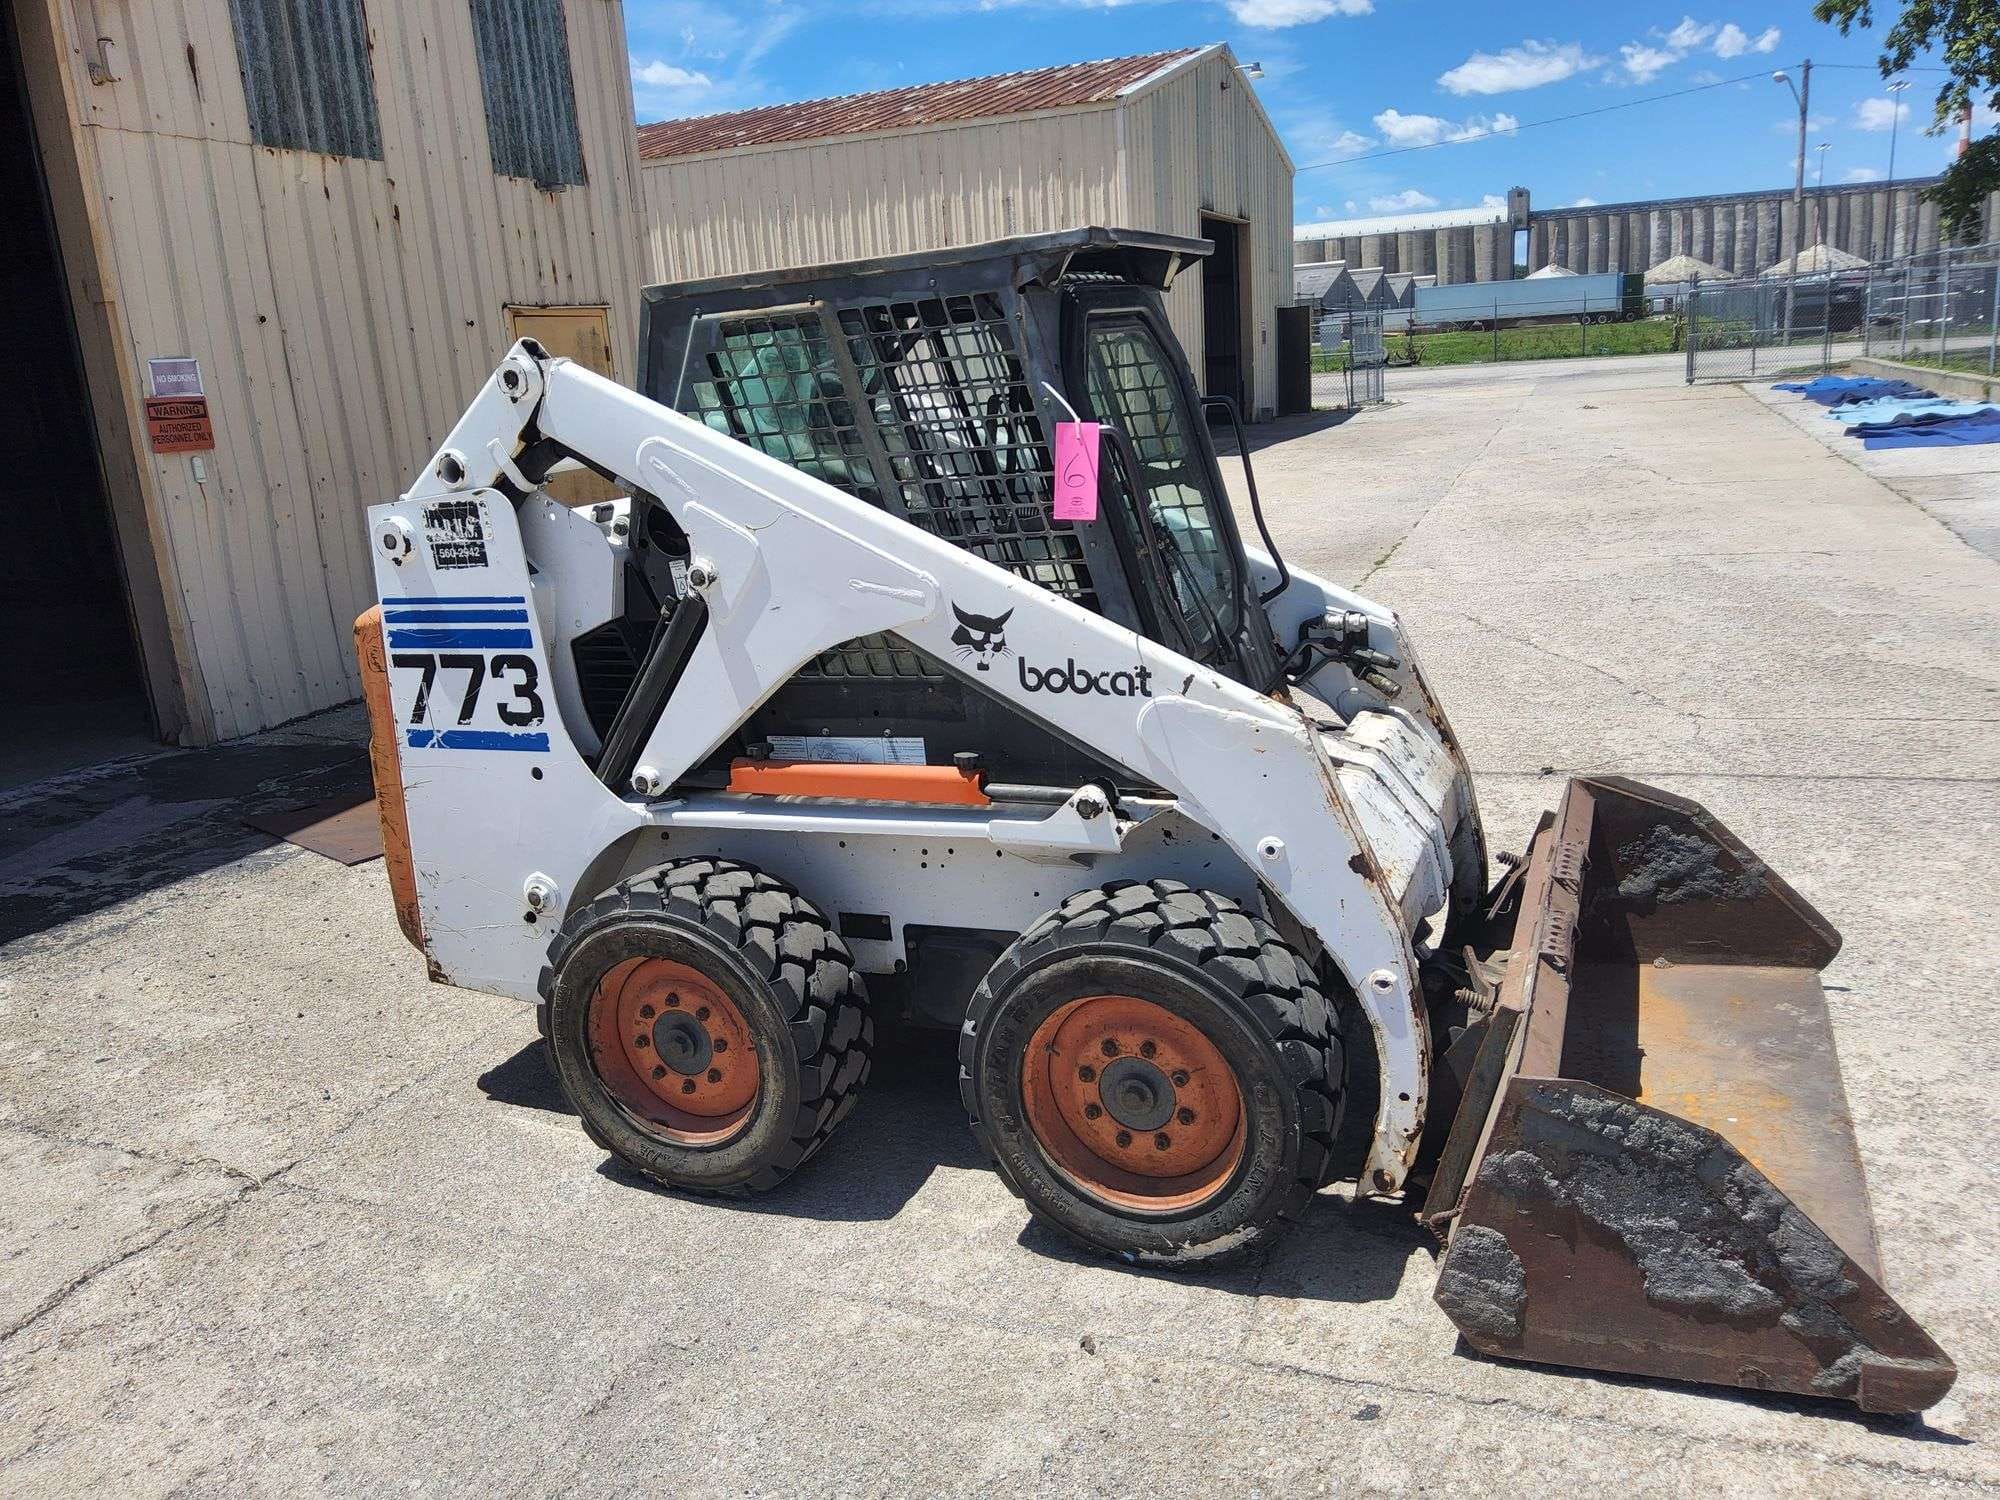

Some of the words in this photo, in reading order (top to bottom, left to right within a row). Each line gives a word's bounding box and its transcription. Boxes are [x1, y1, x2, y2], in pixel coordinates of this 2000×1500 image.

[156, 375, 166, 384] NO
[167, 373, 197, 383] SMOKING
[153, 405, 200, 417] WARNING
[159, 422, 202, 434] AUTHORIZED
[152, 433, 194, 445] PERSONNEL
[194, 432, 212, 442] ONLY
[1063, 453, 1086, 488] 6
[1018, 656, 1152, 698] bobcat
[391, 653, 545, 727] 773
